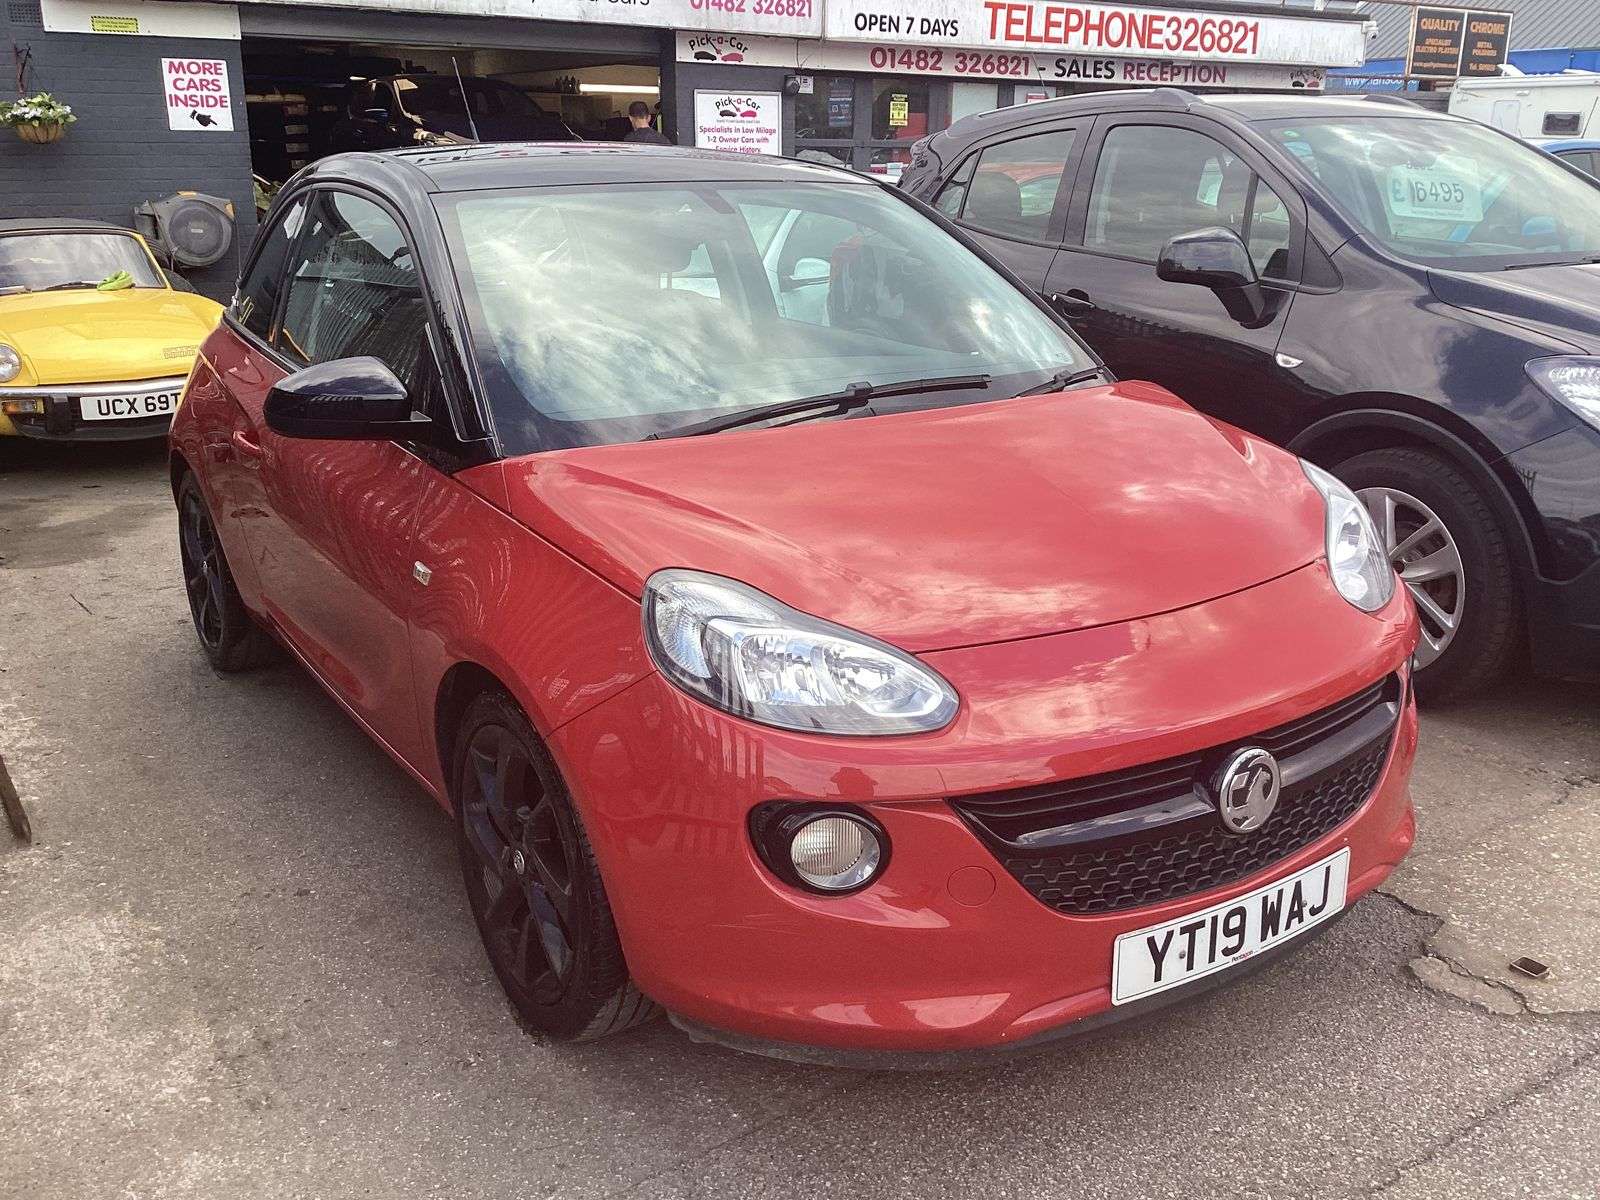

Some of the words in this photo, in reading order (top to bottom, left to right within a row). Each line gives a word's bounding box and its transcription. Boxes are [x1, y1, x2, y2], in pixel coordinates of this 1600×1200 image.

[752, 0, 812, 18] 326821
[854, 12, 900, 34] OPEN
[906, 16, 915, 35] 7
[920, 18, 959, 37] DAYS
[1420, 18, 1460, 31] QUALITY
[1470, 21, 1505, 35] CHROME
[168, 61, 223, 75] MORE
[870, 47, 943, 71] 01482
[954, 52, 1030, 76] 326821
[1054, 57, 1116, 80] SALES
[1123, 61, 1228, 84] RECEPTION
[172, 77, 222, 92] CARS
[168, 94, 229, 108] INSIDE
[699, 125, 733, 134] Specialists
[97, 397, 139, 416] UCX
[144, 392, 182, 412] 69T
[1146, 905, 1248, 983] YT19
[1260, 865, 1331, 943] WAJ
